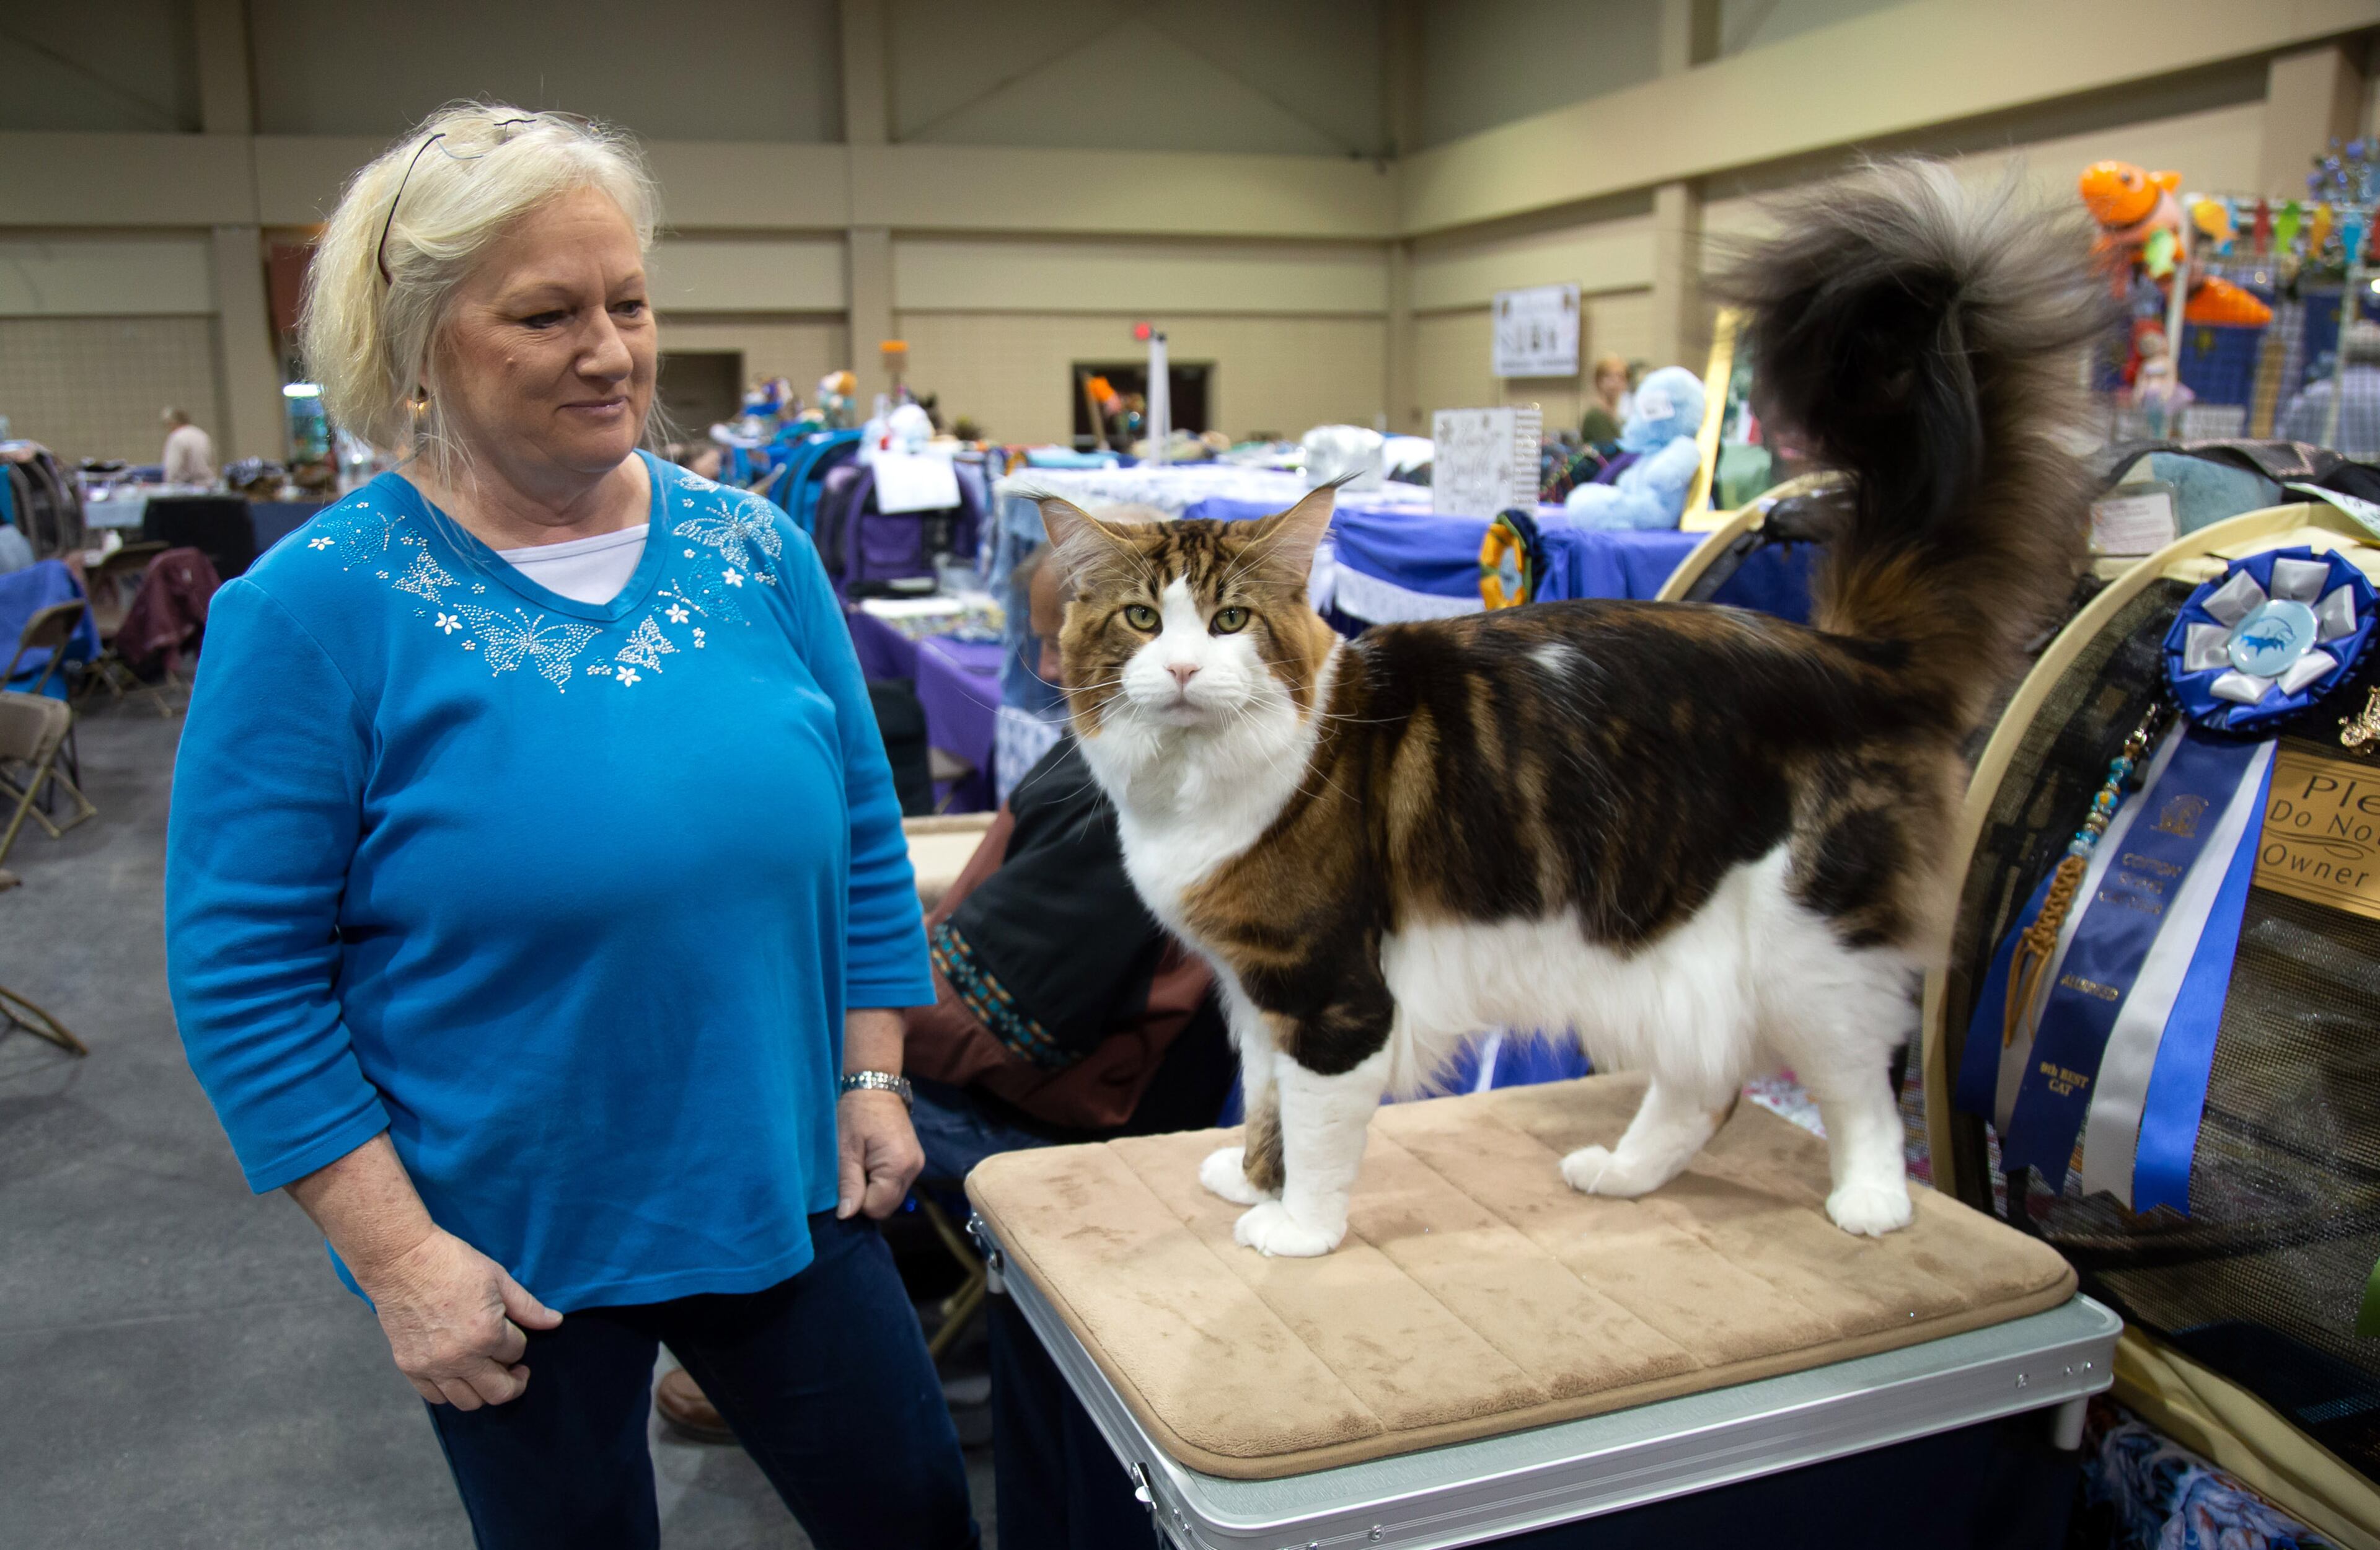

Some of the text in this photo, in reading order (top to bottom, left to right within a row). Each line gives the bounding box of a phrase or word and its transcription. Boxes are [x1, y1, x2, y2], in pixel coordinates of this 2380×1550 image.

[2269, 799, 2380, 846] Do No
[2263, 843, 2369, 887] Owner
[2048, 1078, 2073, 1096] CAT
[2060, 1067, 2089, 1089] BEST
